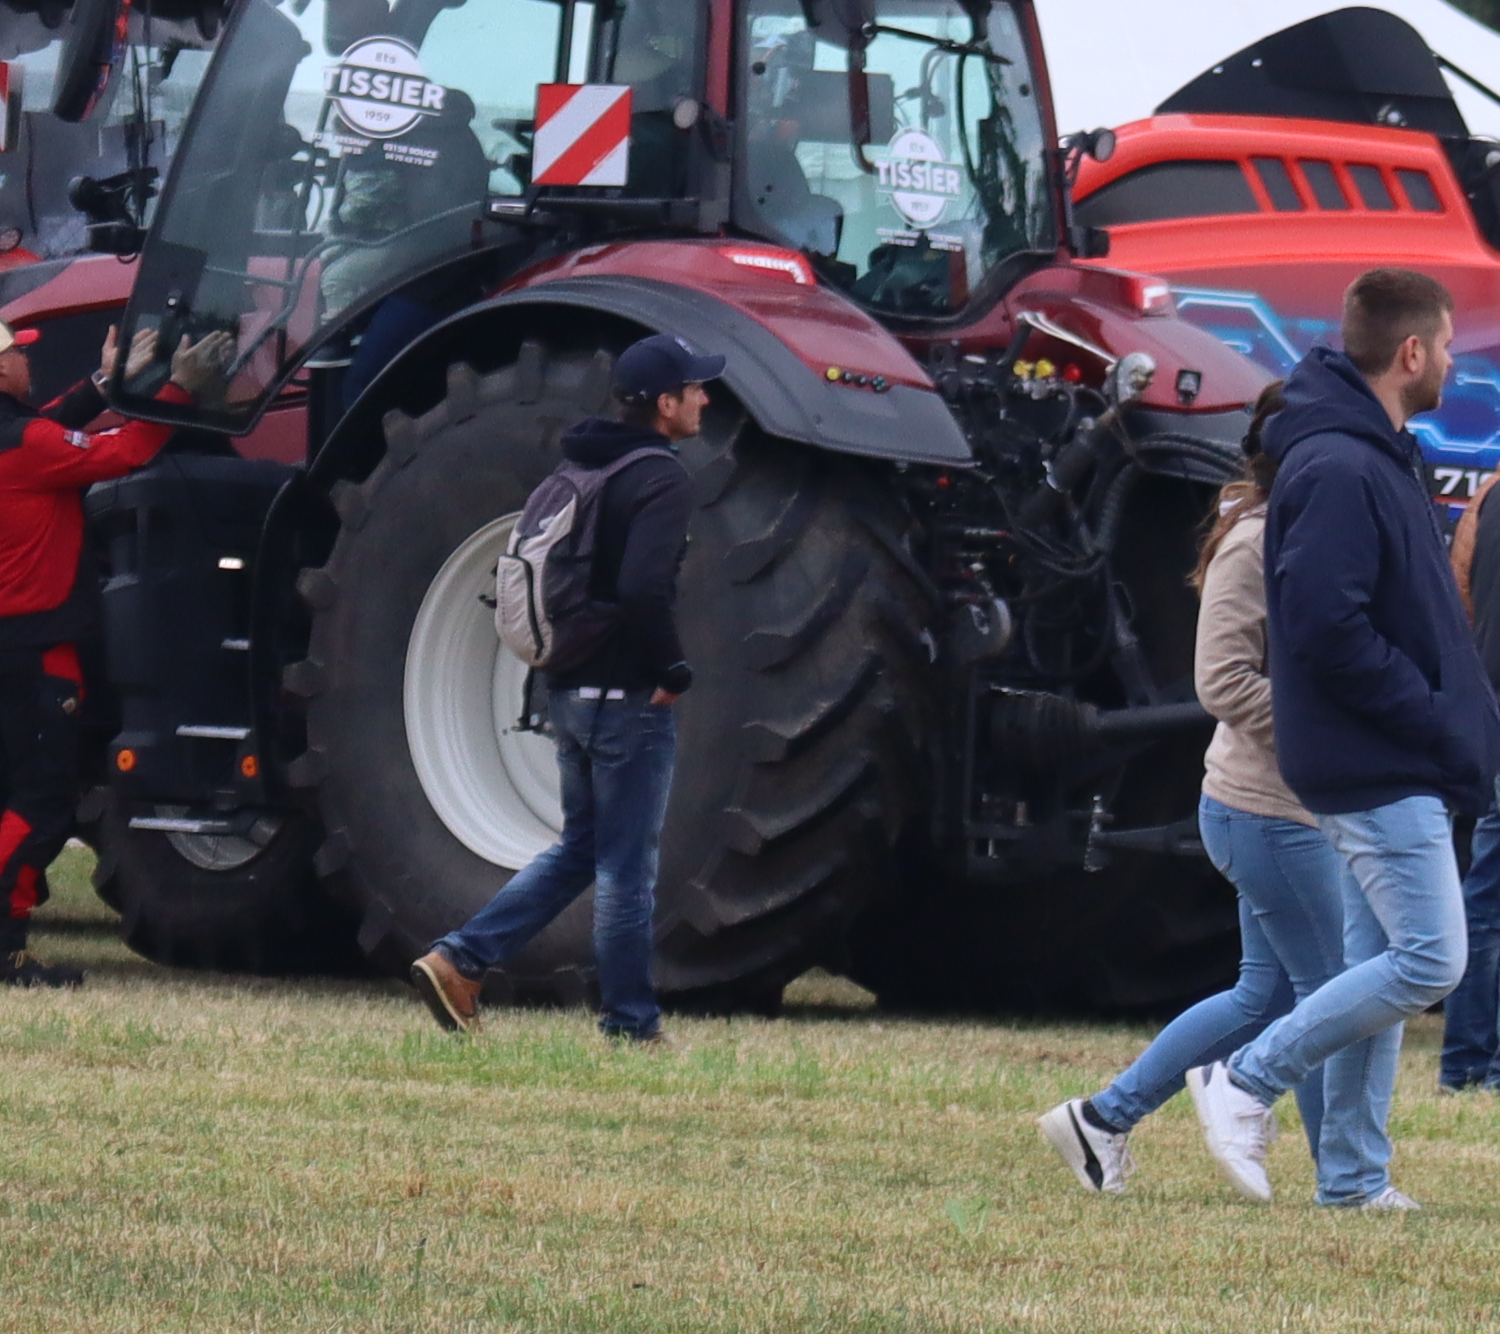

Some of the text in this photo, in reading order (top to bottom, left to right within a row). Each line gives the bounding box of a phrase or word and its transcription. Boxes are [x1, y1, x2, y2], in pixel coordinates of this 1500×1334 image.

[323, 67, 446, 110] TISSIER
[364, 109, 391, 123] 1959
[875, 160, 960, 194] TISSIER
